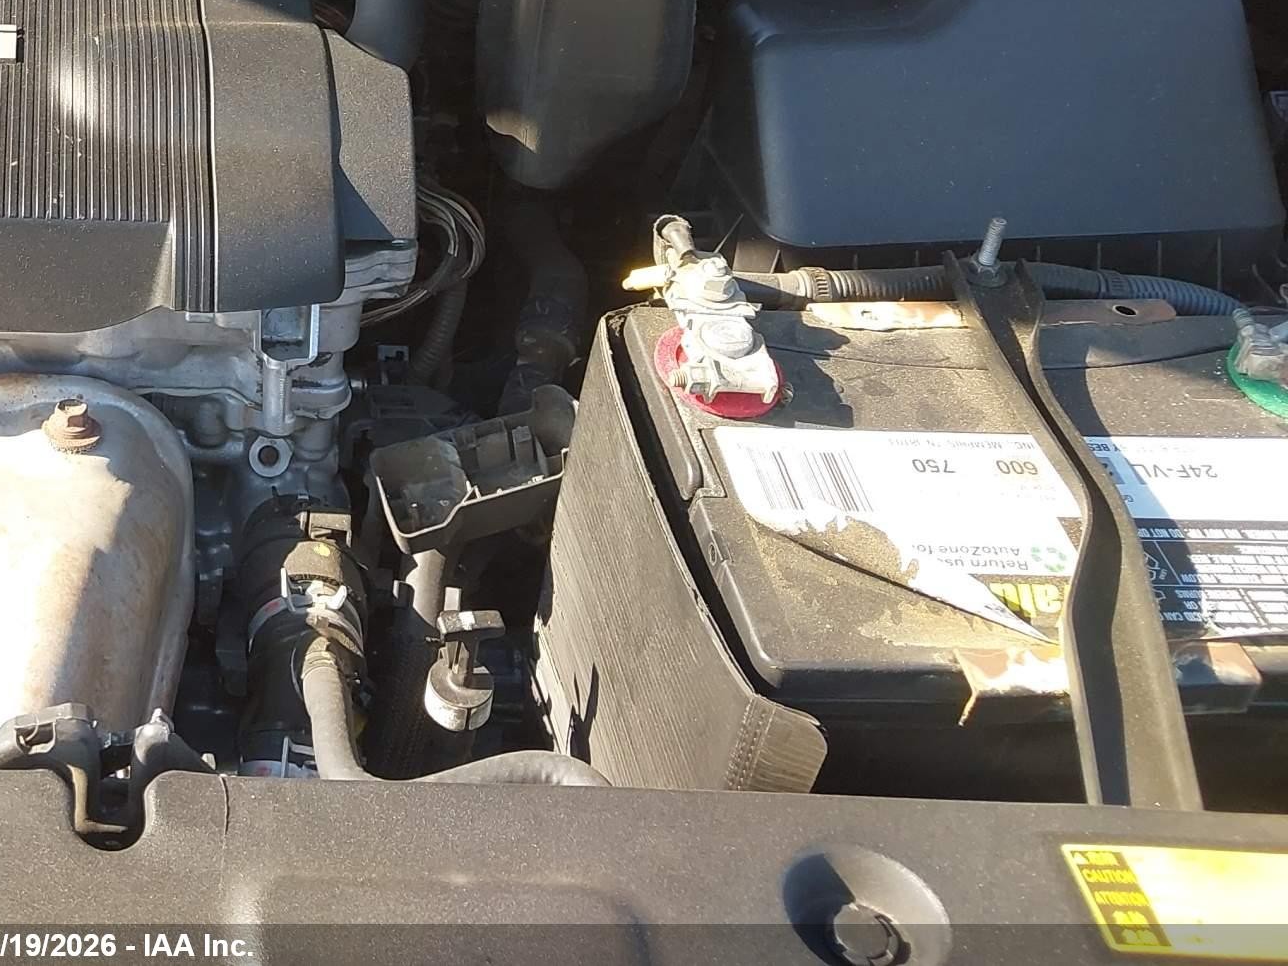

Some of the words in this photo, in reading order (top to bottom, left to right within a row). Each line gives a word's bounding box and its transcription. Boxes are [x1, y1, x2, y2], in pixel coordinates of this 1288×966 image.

[911, 459, 956, 474] 750
[995, 460, 1039, 476] 600
[911, 544, 933, 555] fo
[939, 545, 1020, 556] AutoZone
[936, 558, 965, 569] us
[970, 559, 1029, 571] Return
[1183, 601, 1199, 610] OR
[1163, 612, 1184, 621] CAN
[1081, 869, 1138, 884] CAUTION
